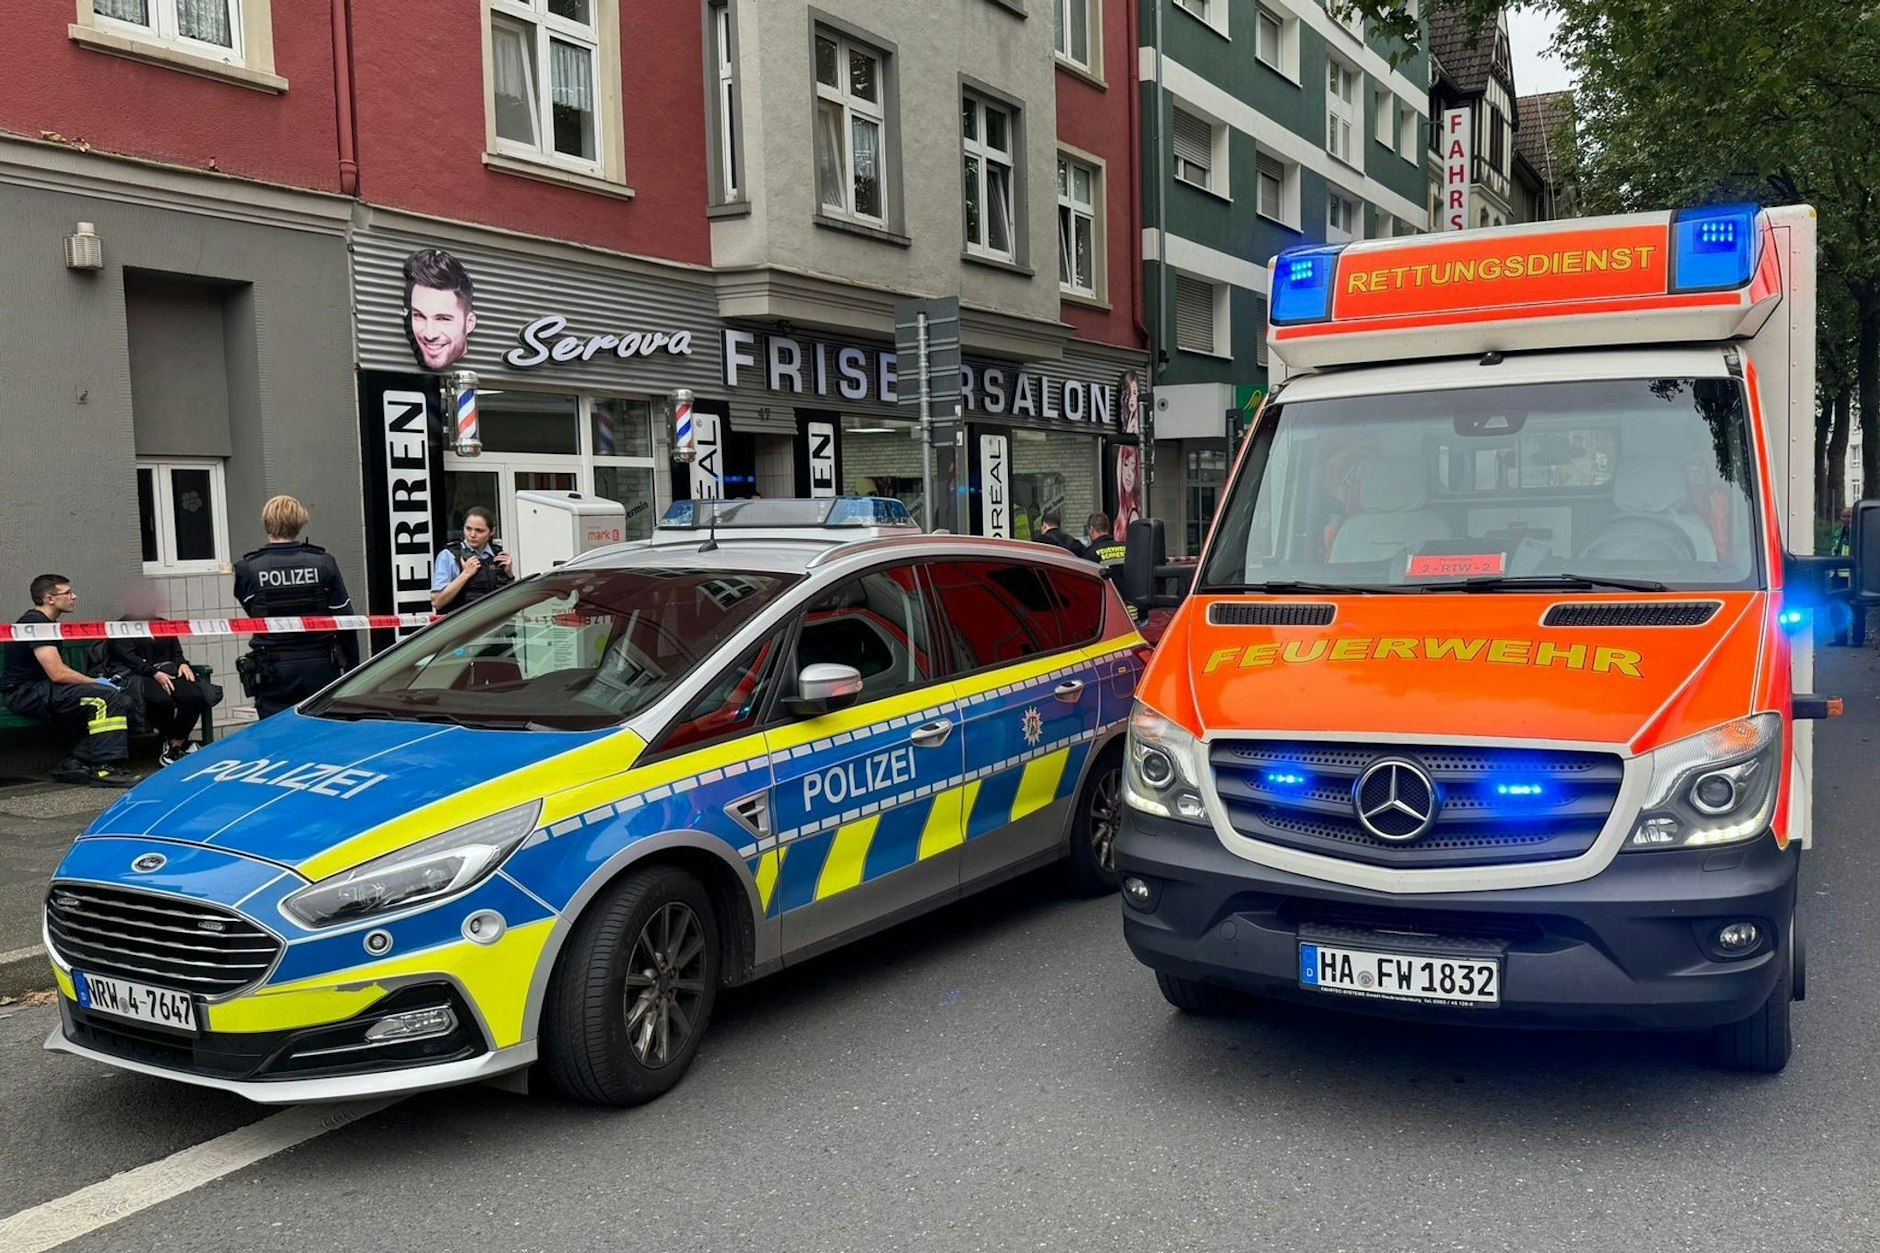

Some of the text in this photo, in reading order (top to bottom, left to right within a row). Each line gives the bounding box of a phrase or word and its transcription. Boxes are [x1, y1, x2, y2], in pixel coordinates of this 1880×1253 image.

[1448, 114, 1464, 231] FAHRS
[1347, 245, 1656, 294] RETTUNGSDIENST
[506, 315, 692, 367] Serova
[724, 328, 1110, 424] FRISERSALON
[626, 501, 649, 520] ermin
[588, 530, 611, 540] mark
[259, 568, 319, 586] POLIZEI
[1441, 563, 1471, 573] RTW
[1202, 637, 1645, 678] FEUERWEHR
[181, 758, 389, 800] POLIZEI
[803, 746, 916, 812] POLIZEI
[1320, 951, 1354, 985] HA
[1377, 957, 1413, 991] FW
[1420, 962, 1495, 997] 1832
[86, 977, 119, 1010] NRW
[128, 985, 191, 1025] 4-7647
